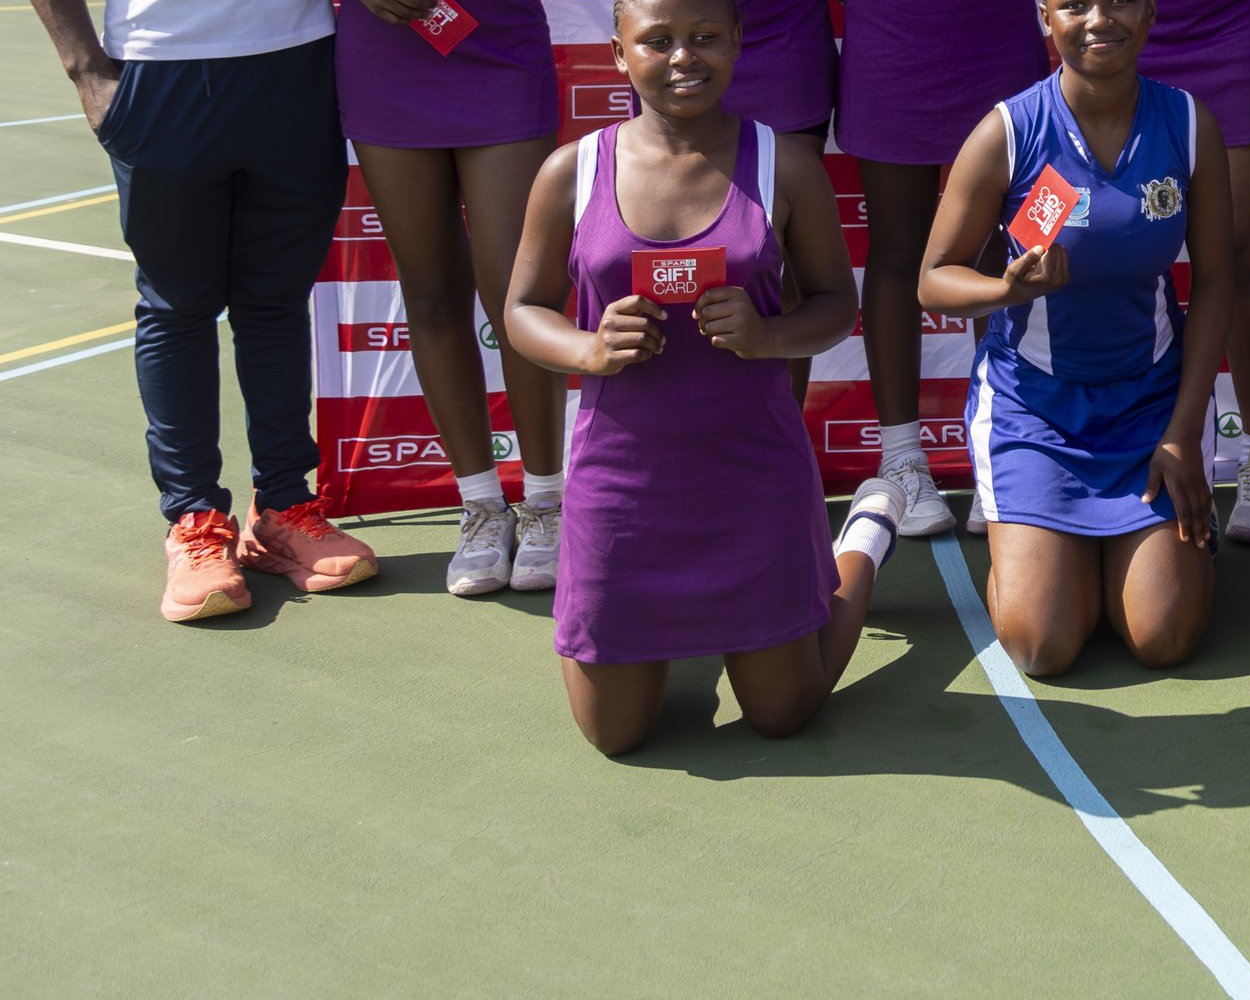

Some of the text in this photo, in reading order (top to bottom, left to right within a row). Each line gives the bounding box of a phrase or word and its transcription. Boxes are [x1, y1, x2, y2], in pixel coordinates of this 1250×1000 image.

[428, 6, 453, 26] IFT
[418, 18, 441, 35] ARD
[1027, 186, 1050, 221] CARD
[1035, 194, 1060, 231] GIFT
[653, 267, 697, 282] GIFT
[653, 281, 698, 295] CARD
[860, 424, 964, 445] SAR
[368, 440, 447, 463] SPA
